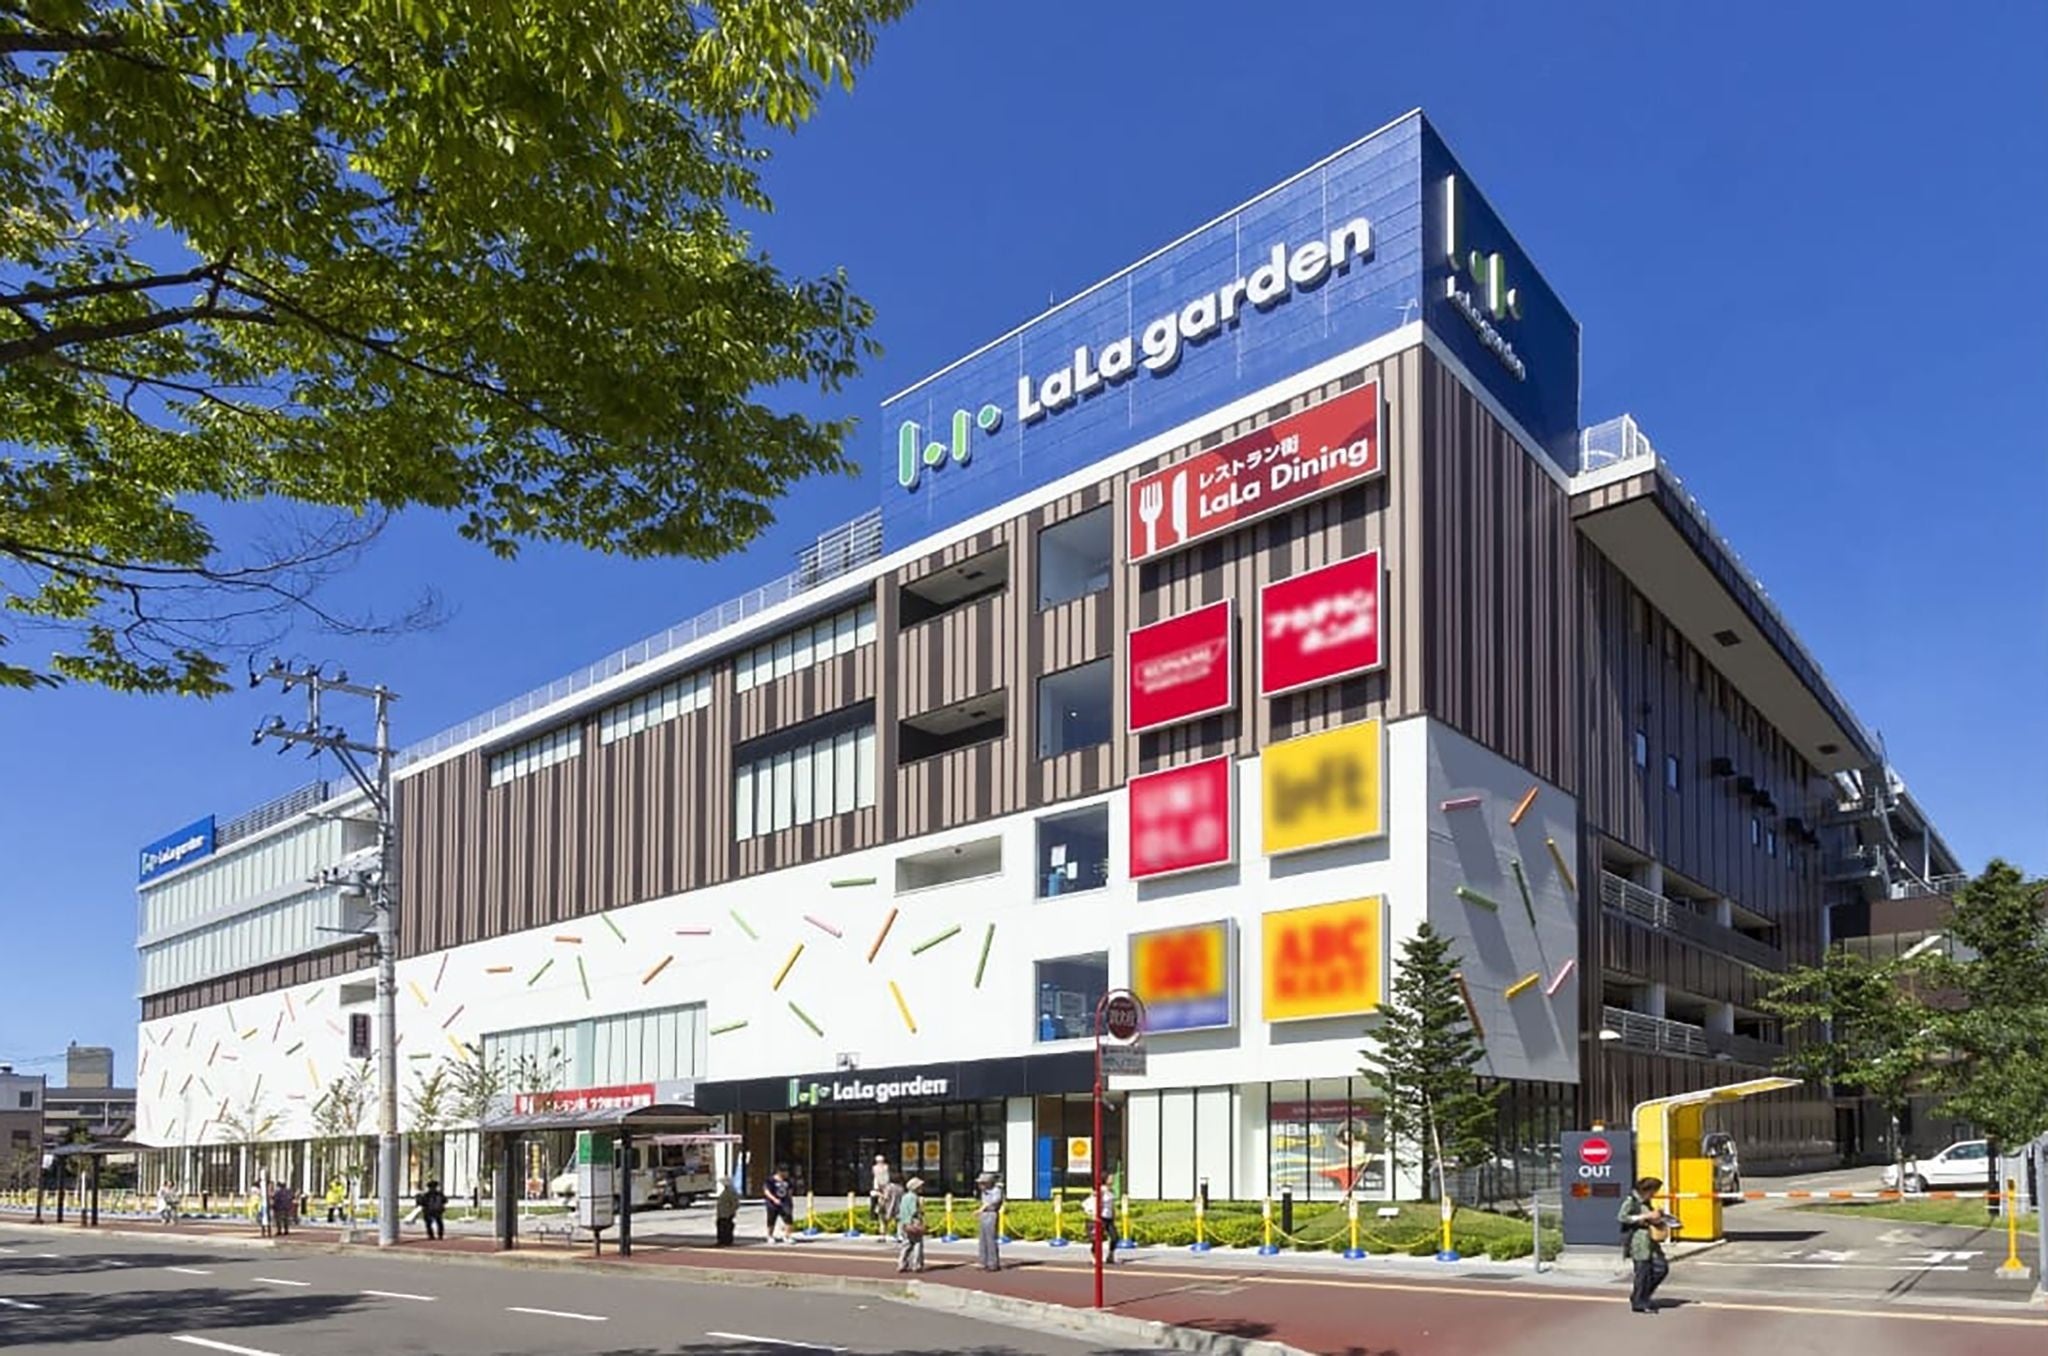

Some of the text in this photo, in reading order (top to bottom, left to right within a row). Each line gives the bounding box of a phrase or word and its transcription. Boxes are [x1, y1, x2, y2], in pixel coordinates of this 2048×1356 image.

[1018, 215, 1373, 423] LaLa garden
[1199, 434, 1300, 490] レストラン街
[1199, 438, 1369, 519] LaLa Dining
[833, 1075, 948, 1102] LaLa garden
[1578, 1165, 1611, 1178] OUT
